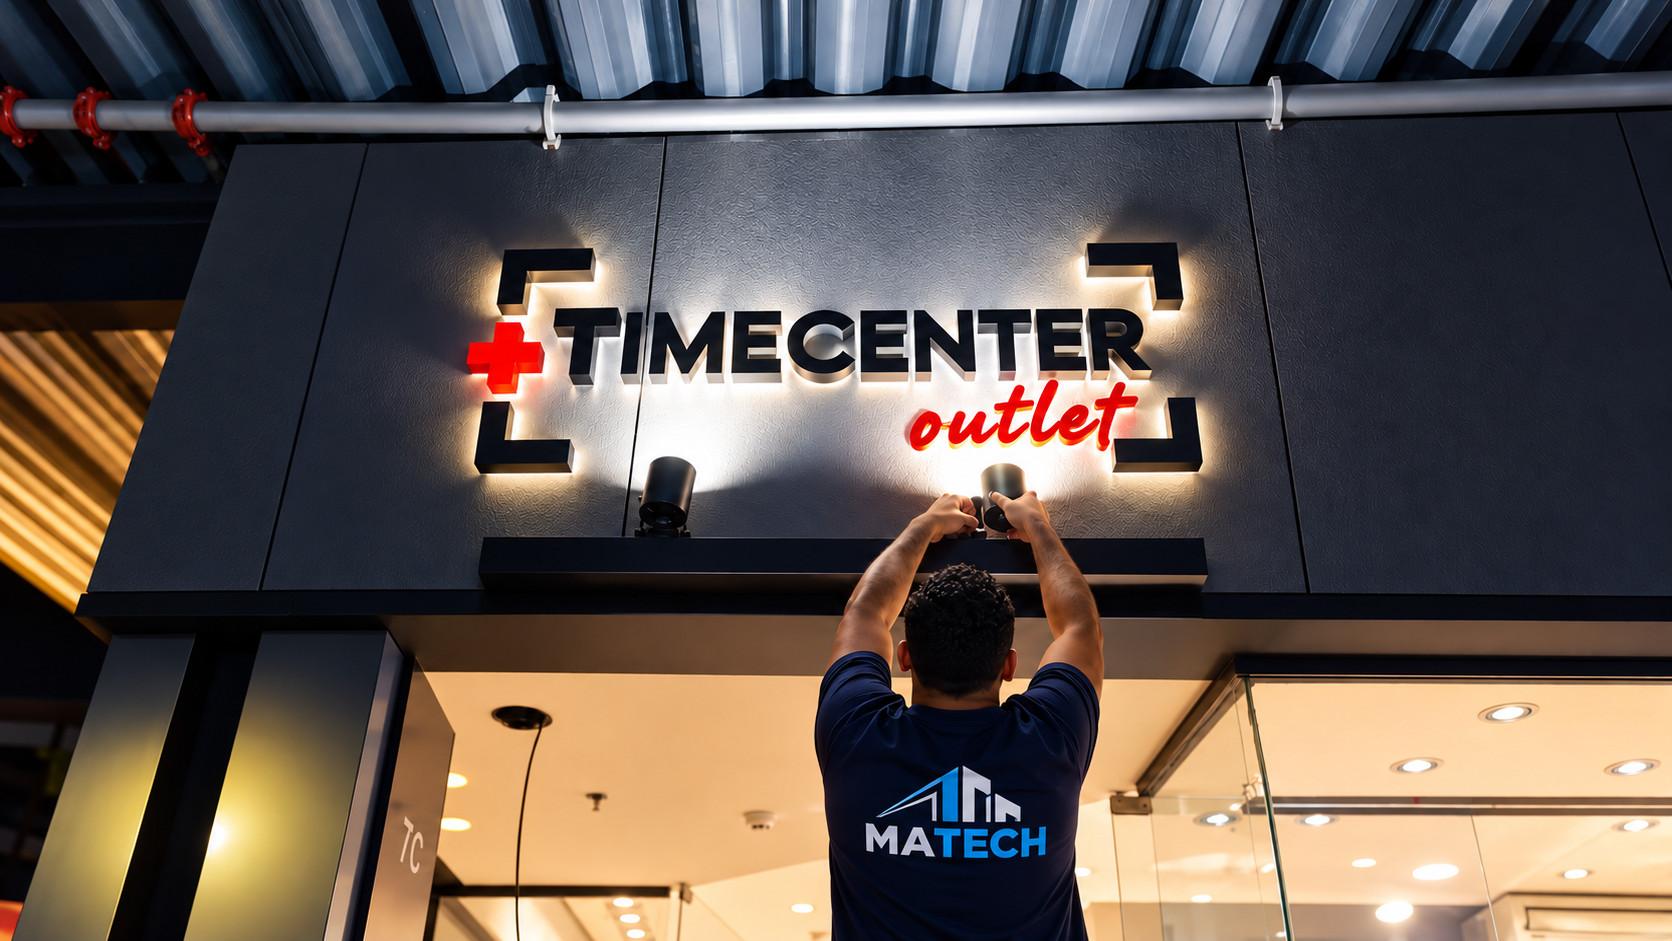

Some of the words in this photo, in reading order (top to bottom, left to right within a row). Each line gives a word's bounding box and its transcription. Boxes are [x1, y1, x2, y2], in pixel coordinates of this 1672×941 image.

[553, 307, 1152, 384] TIMECENTER
[908, 379, 1138, 451] outlet
[400, 816, 424, 874] TC
[865, 823, 1047, 859] MATECH
